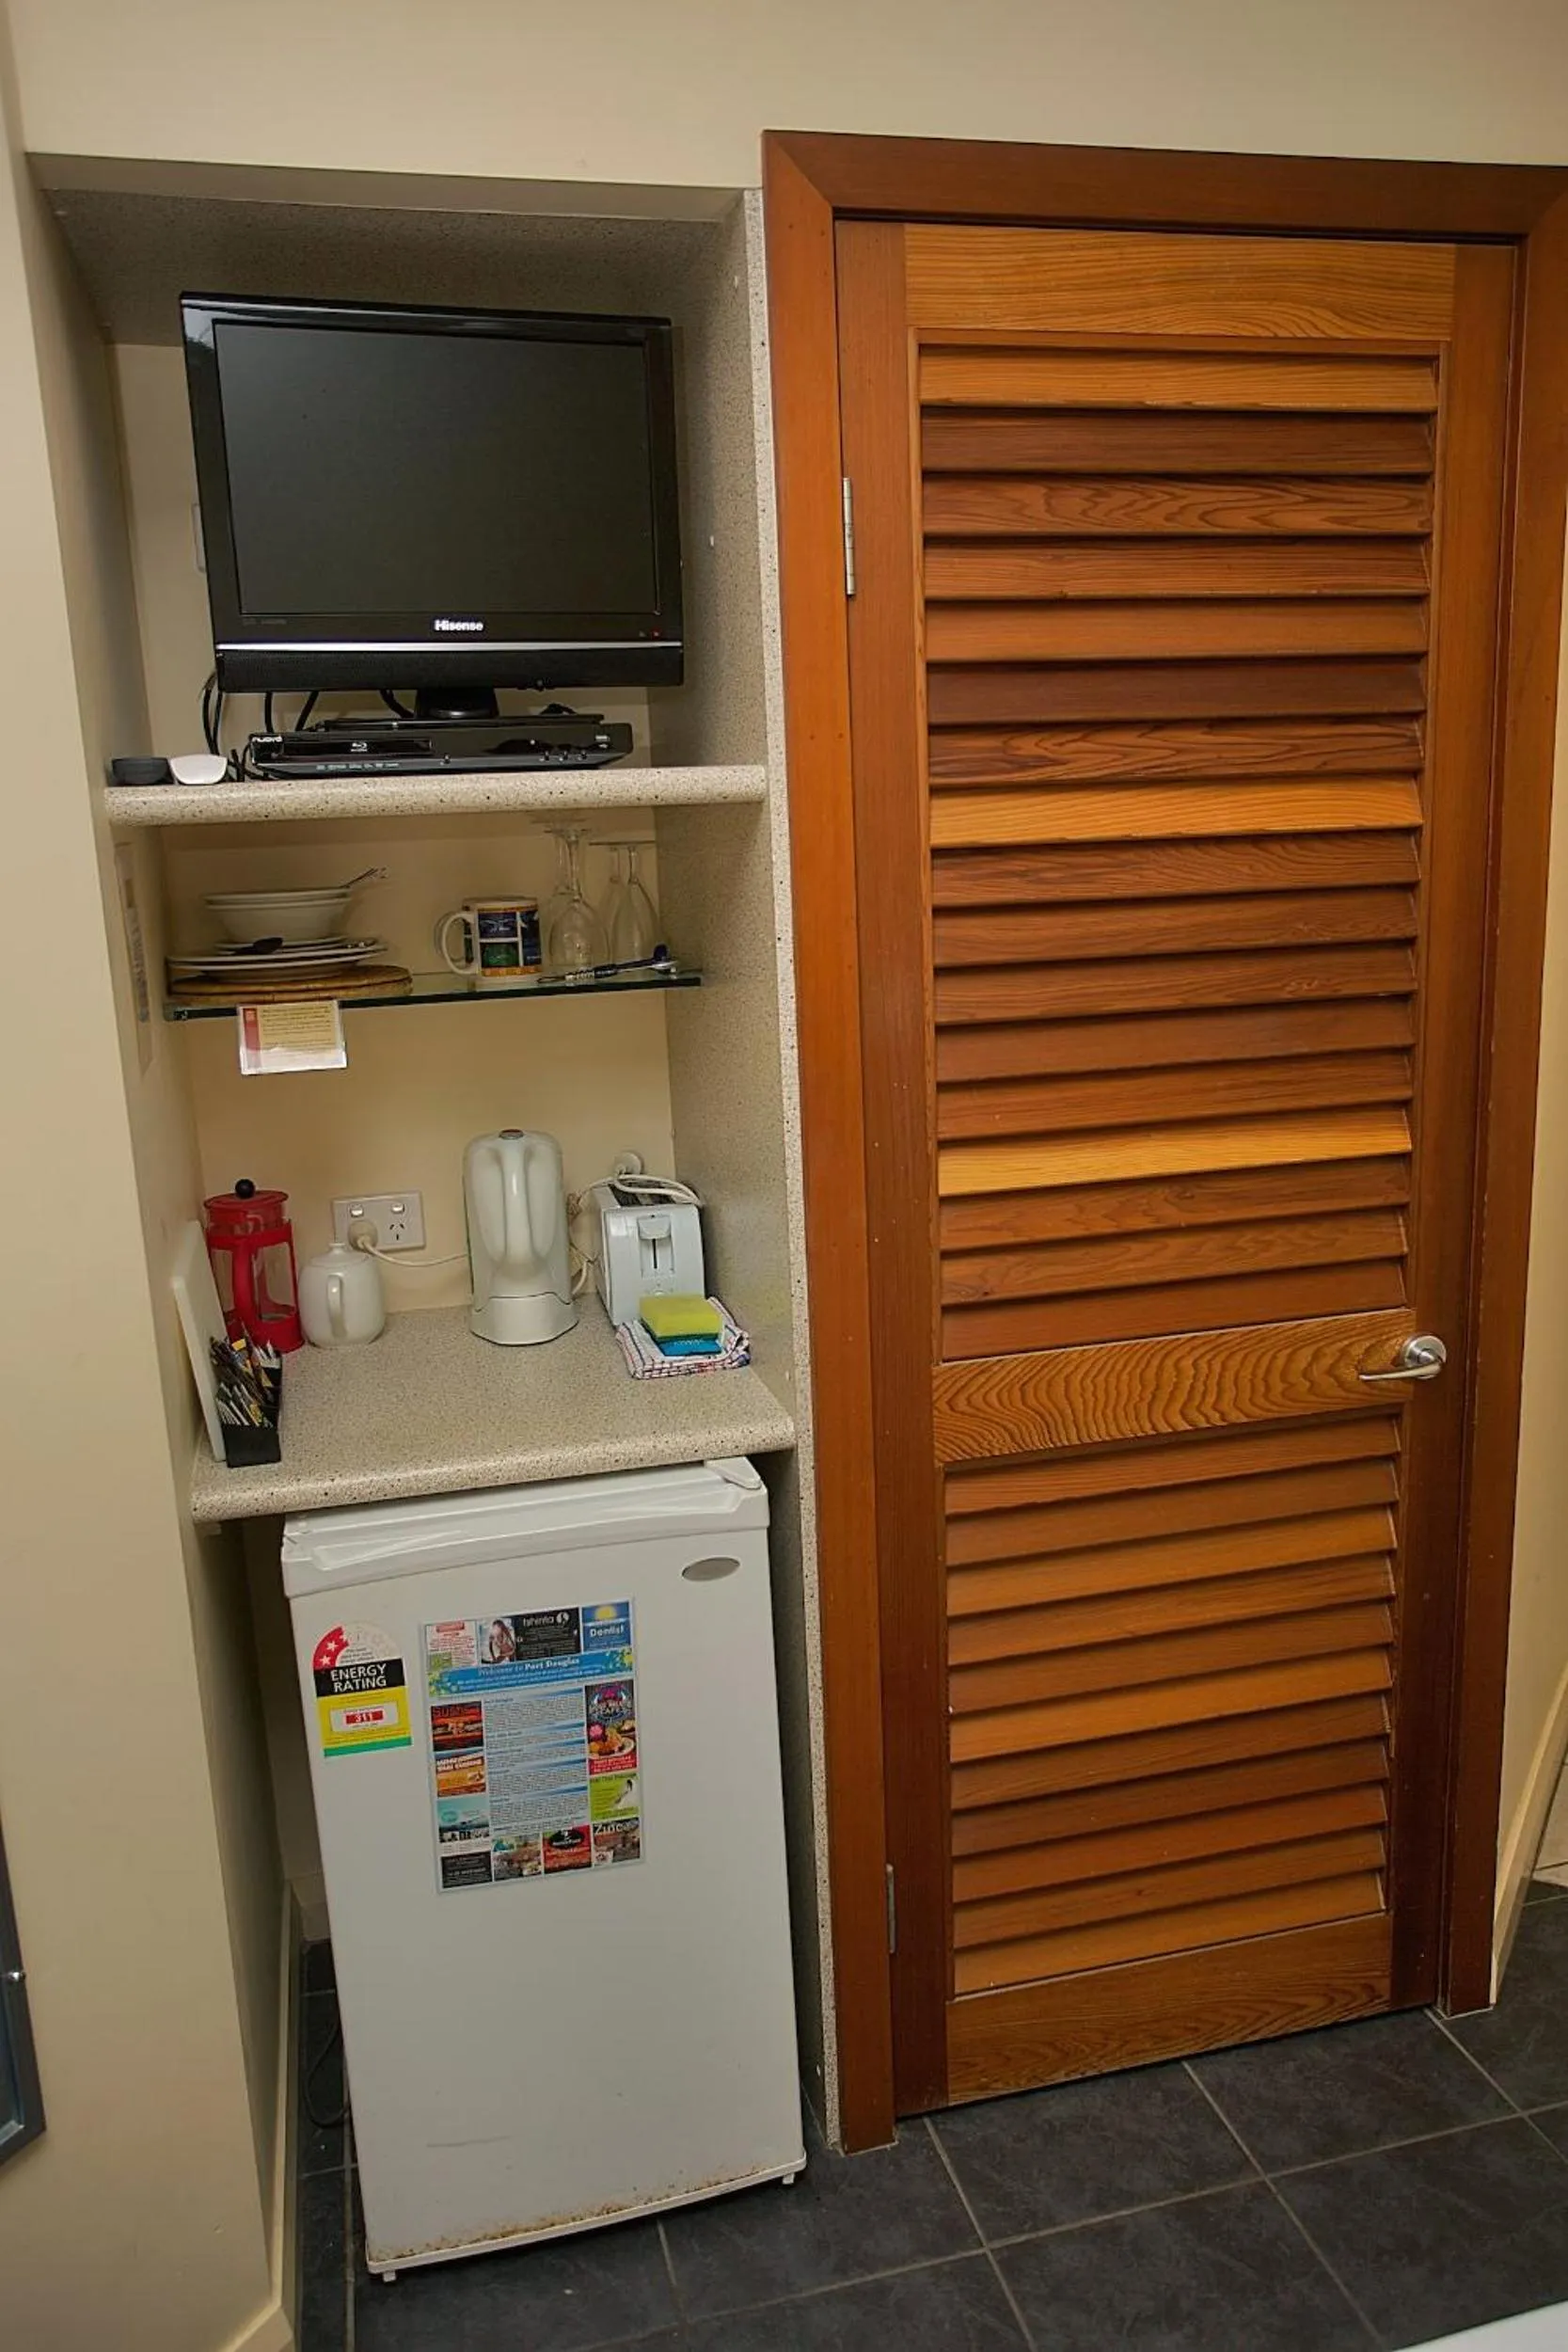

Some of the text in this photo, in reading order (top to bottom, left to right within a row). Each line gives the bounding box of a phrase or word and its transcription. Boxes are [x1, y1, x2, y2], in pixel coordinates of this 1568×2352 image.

[435, 619, 483, 631] Hisense
[590, 1625, 625, 1637] Dentist
[330, 1663, 387, 1681] ENERGY
[525, 1661, 544, 1672] Port
[333, 1676, 387, 1693] RATING
